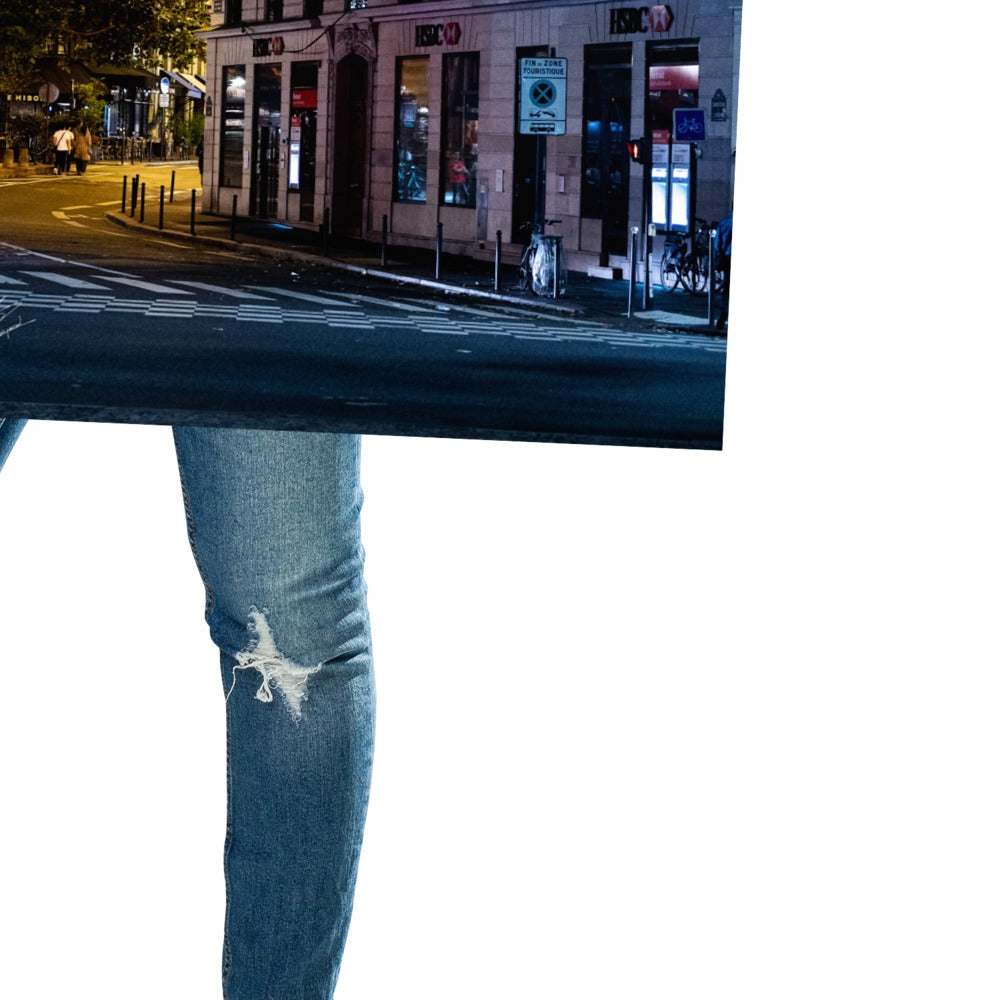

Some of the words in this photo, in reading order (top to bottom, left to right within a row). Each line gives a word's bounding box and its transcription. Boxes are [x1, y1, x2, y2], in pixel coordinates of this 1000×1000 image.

[608, 6, 649, 34] HSBC
[414, 23, 444, 47] HSBC
[523, 67, 565, 75] TOURISTIQUE
